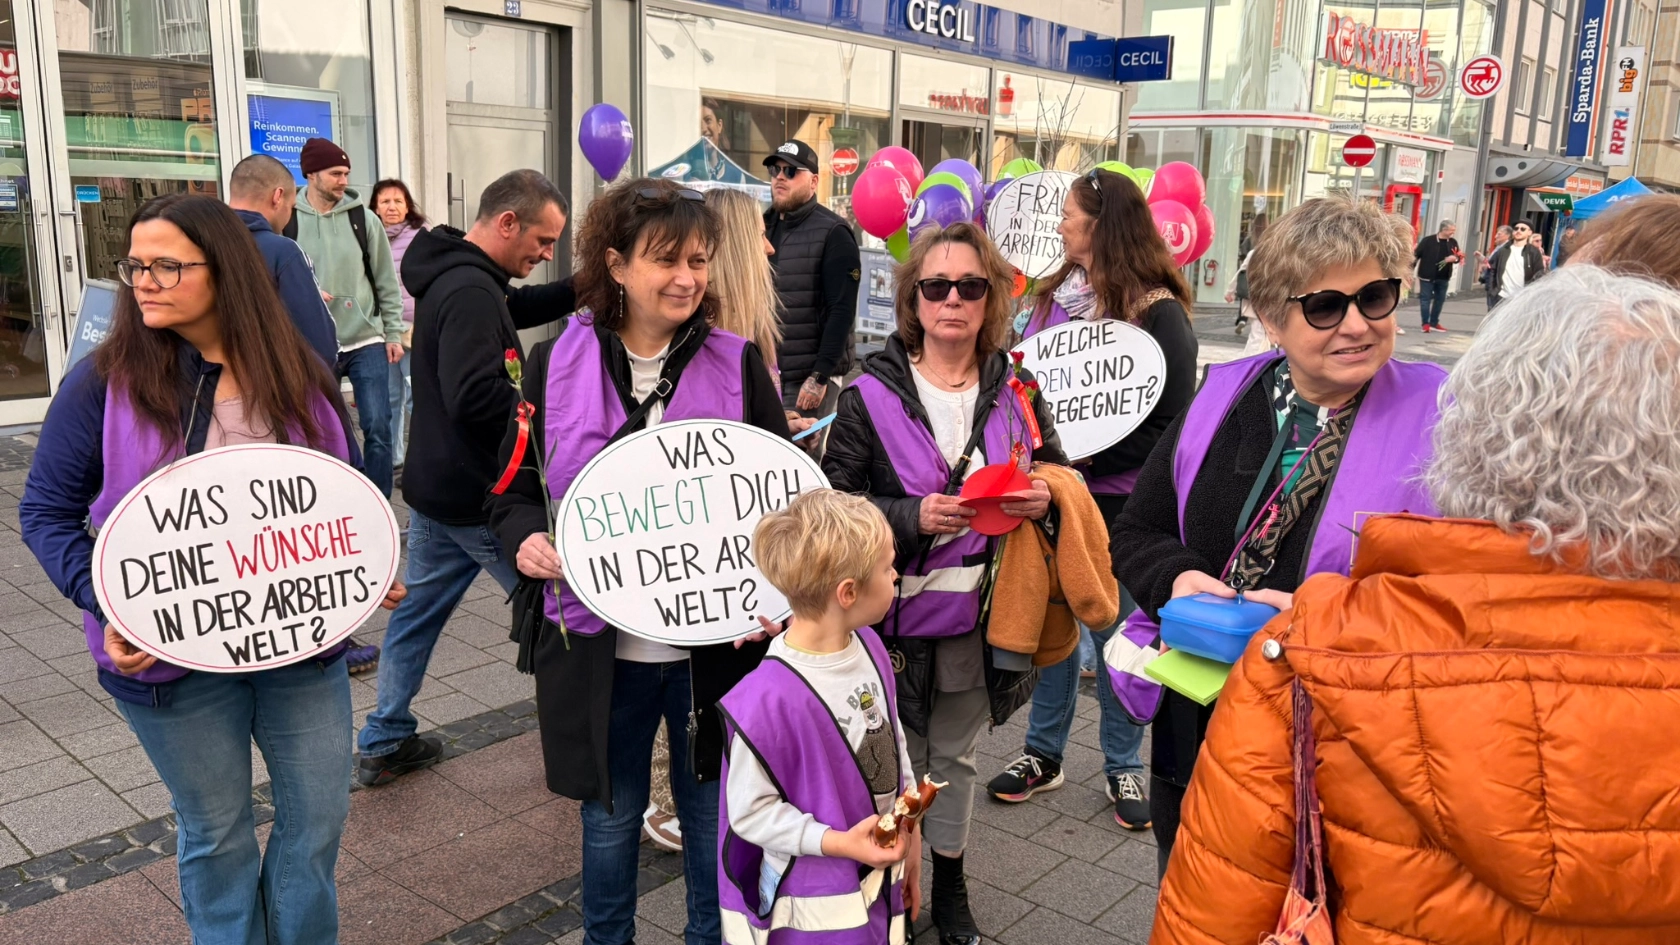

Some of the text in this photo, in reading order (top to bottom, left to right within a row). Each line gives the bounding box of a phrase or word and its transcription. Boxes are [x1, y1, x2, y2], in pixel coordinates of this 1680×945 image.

[507, 1, 519, 14] 23
[906, 0, 974, 42] CECIL
[1120, 51, 1163, 66] CECIL
[1573, 17, 1600, 123] Sparda-Bank
[254, 120, 320, 134] Reinkommen.
[1010, 217, 1059, 234] IN DER
[1037, 321, 1117, 361] WELCHE
[1035, 355, 1134, 393] DEN SIND
[656, 427, 735, 470] WAS
[144, 475, 317, 533] WAS SIND
[575, 469, 801, 542] BEWEGT DICH
[119, 516, 362, 600] DEINE WÜNSCHE
[588, 534, 756, 594] IN DER AR
[153, 565, 378, 644] IN DER ARBEITS-
[654, 578, 758, 627] WELT?
[846, 681, 880, 710] BEAR
